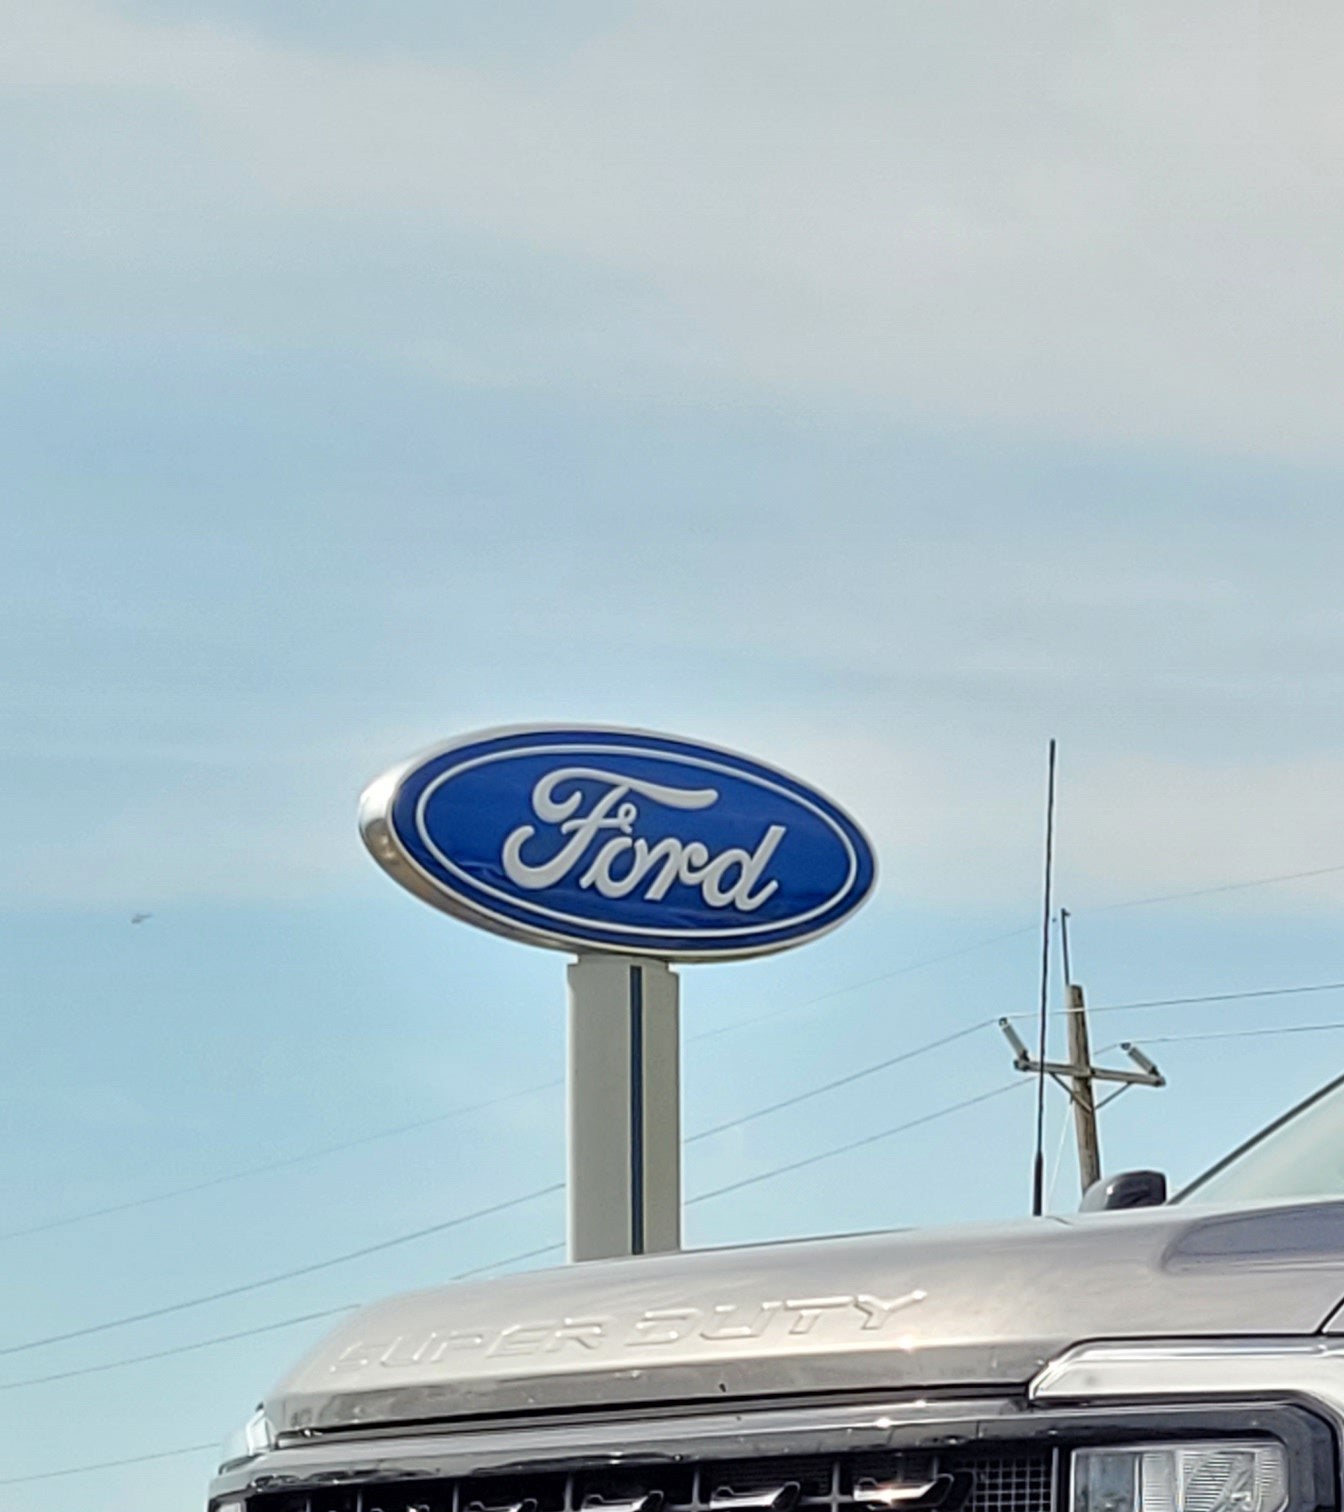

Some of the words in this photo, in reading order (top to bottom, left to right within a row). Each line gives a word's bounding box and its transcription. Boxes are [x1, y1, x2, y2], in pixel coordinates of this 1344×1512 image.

[502, 767, 786, 911] Ford
[329, 1315, 614, 1373] SUPER
[624, 1290, 927, 1346] DUTY
